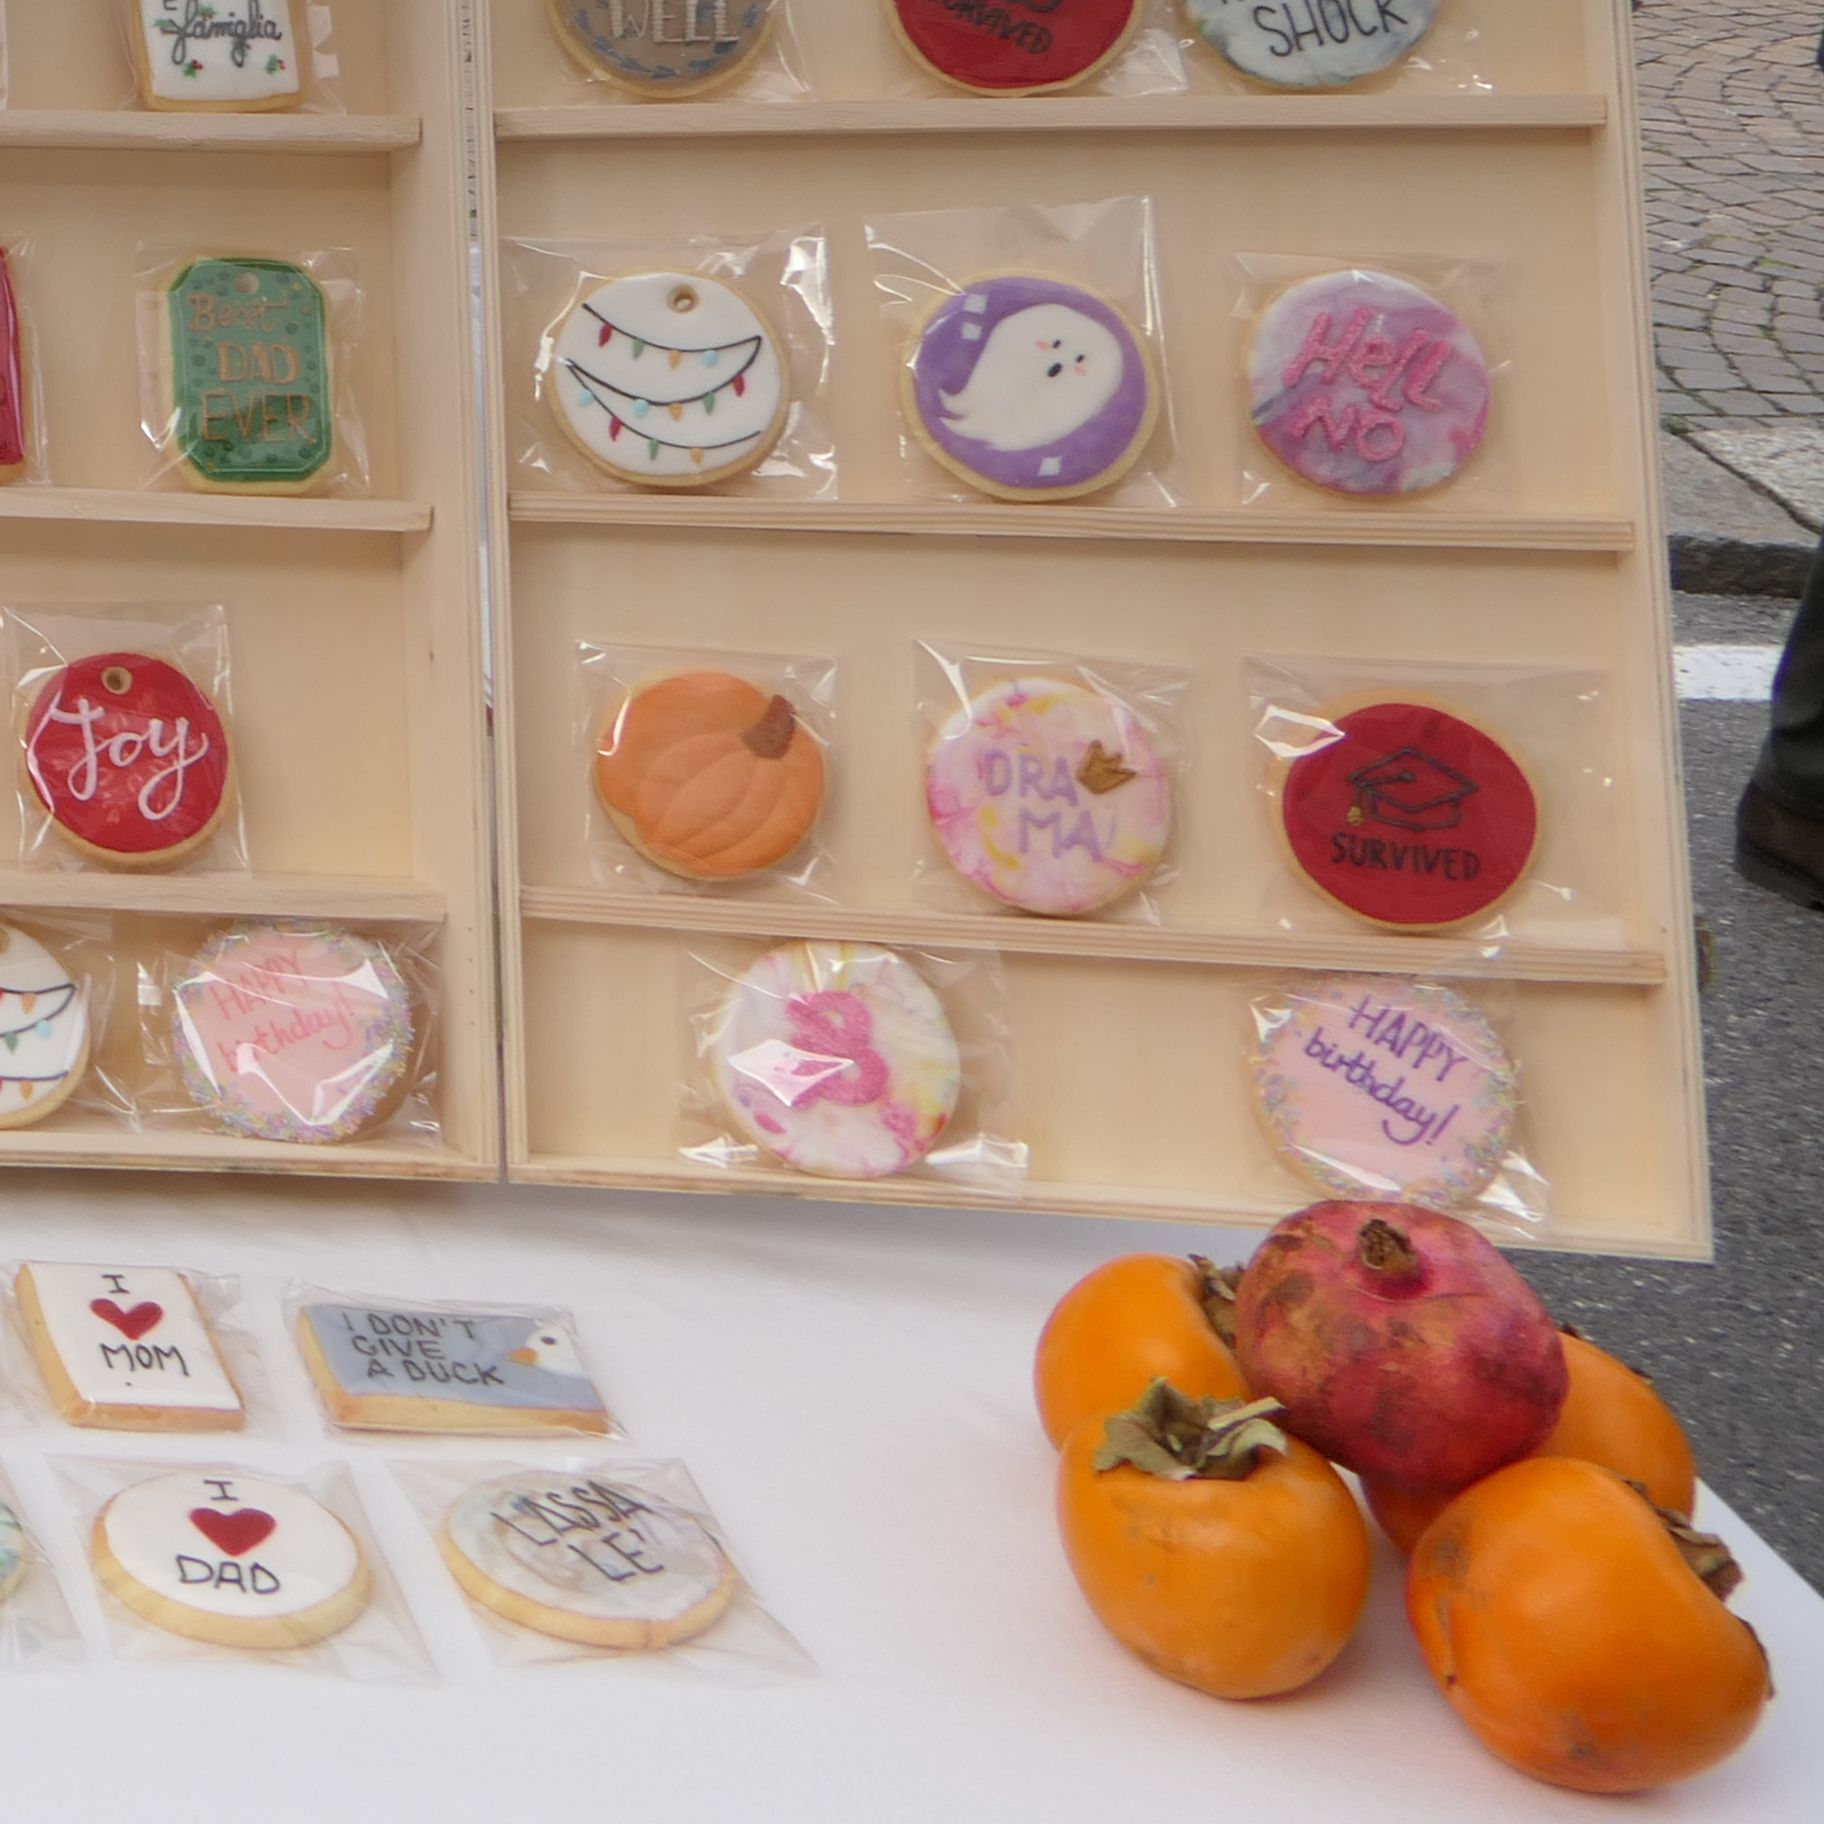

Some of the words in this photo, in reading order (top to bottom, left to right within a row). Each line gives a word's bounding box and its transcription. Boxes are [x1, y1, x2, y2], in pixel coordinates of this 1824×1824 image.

[218, 341, 301, 384] DAD
[1282, 306, 1452, 414] Hell
[200, 389, 317, 445] EVER
[49, 697, 210, 821] Joy
[984, 749, 1079, 807] DRA
[1018, 808, 1103, 864] MA
[1330, 831, 1481, 882] SURVIVED
[1348, 994, 1469, 1083] HAPPY
[1305, 1026, 1461, 1146] birthday!
[102, 1273, 128, 1295] I
[342, 1312, 354, 1332] I
[368, 1313, 475, 1340] DON'T
[352, 1335, 445, 1360] GIVE
[98, 1341, 190, 1378] MOM
[367, 1358, 395, 1378] A
[402, 1359, 505, 1386] DUCK
[203, 1479, 240, 1502] I
[490, 1480, 655, 1546] LASSA
[175, 1552, 282, 1596] DAD
